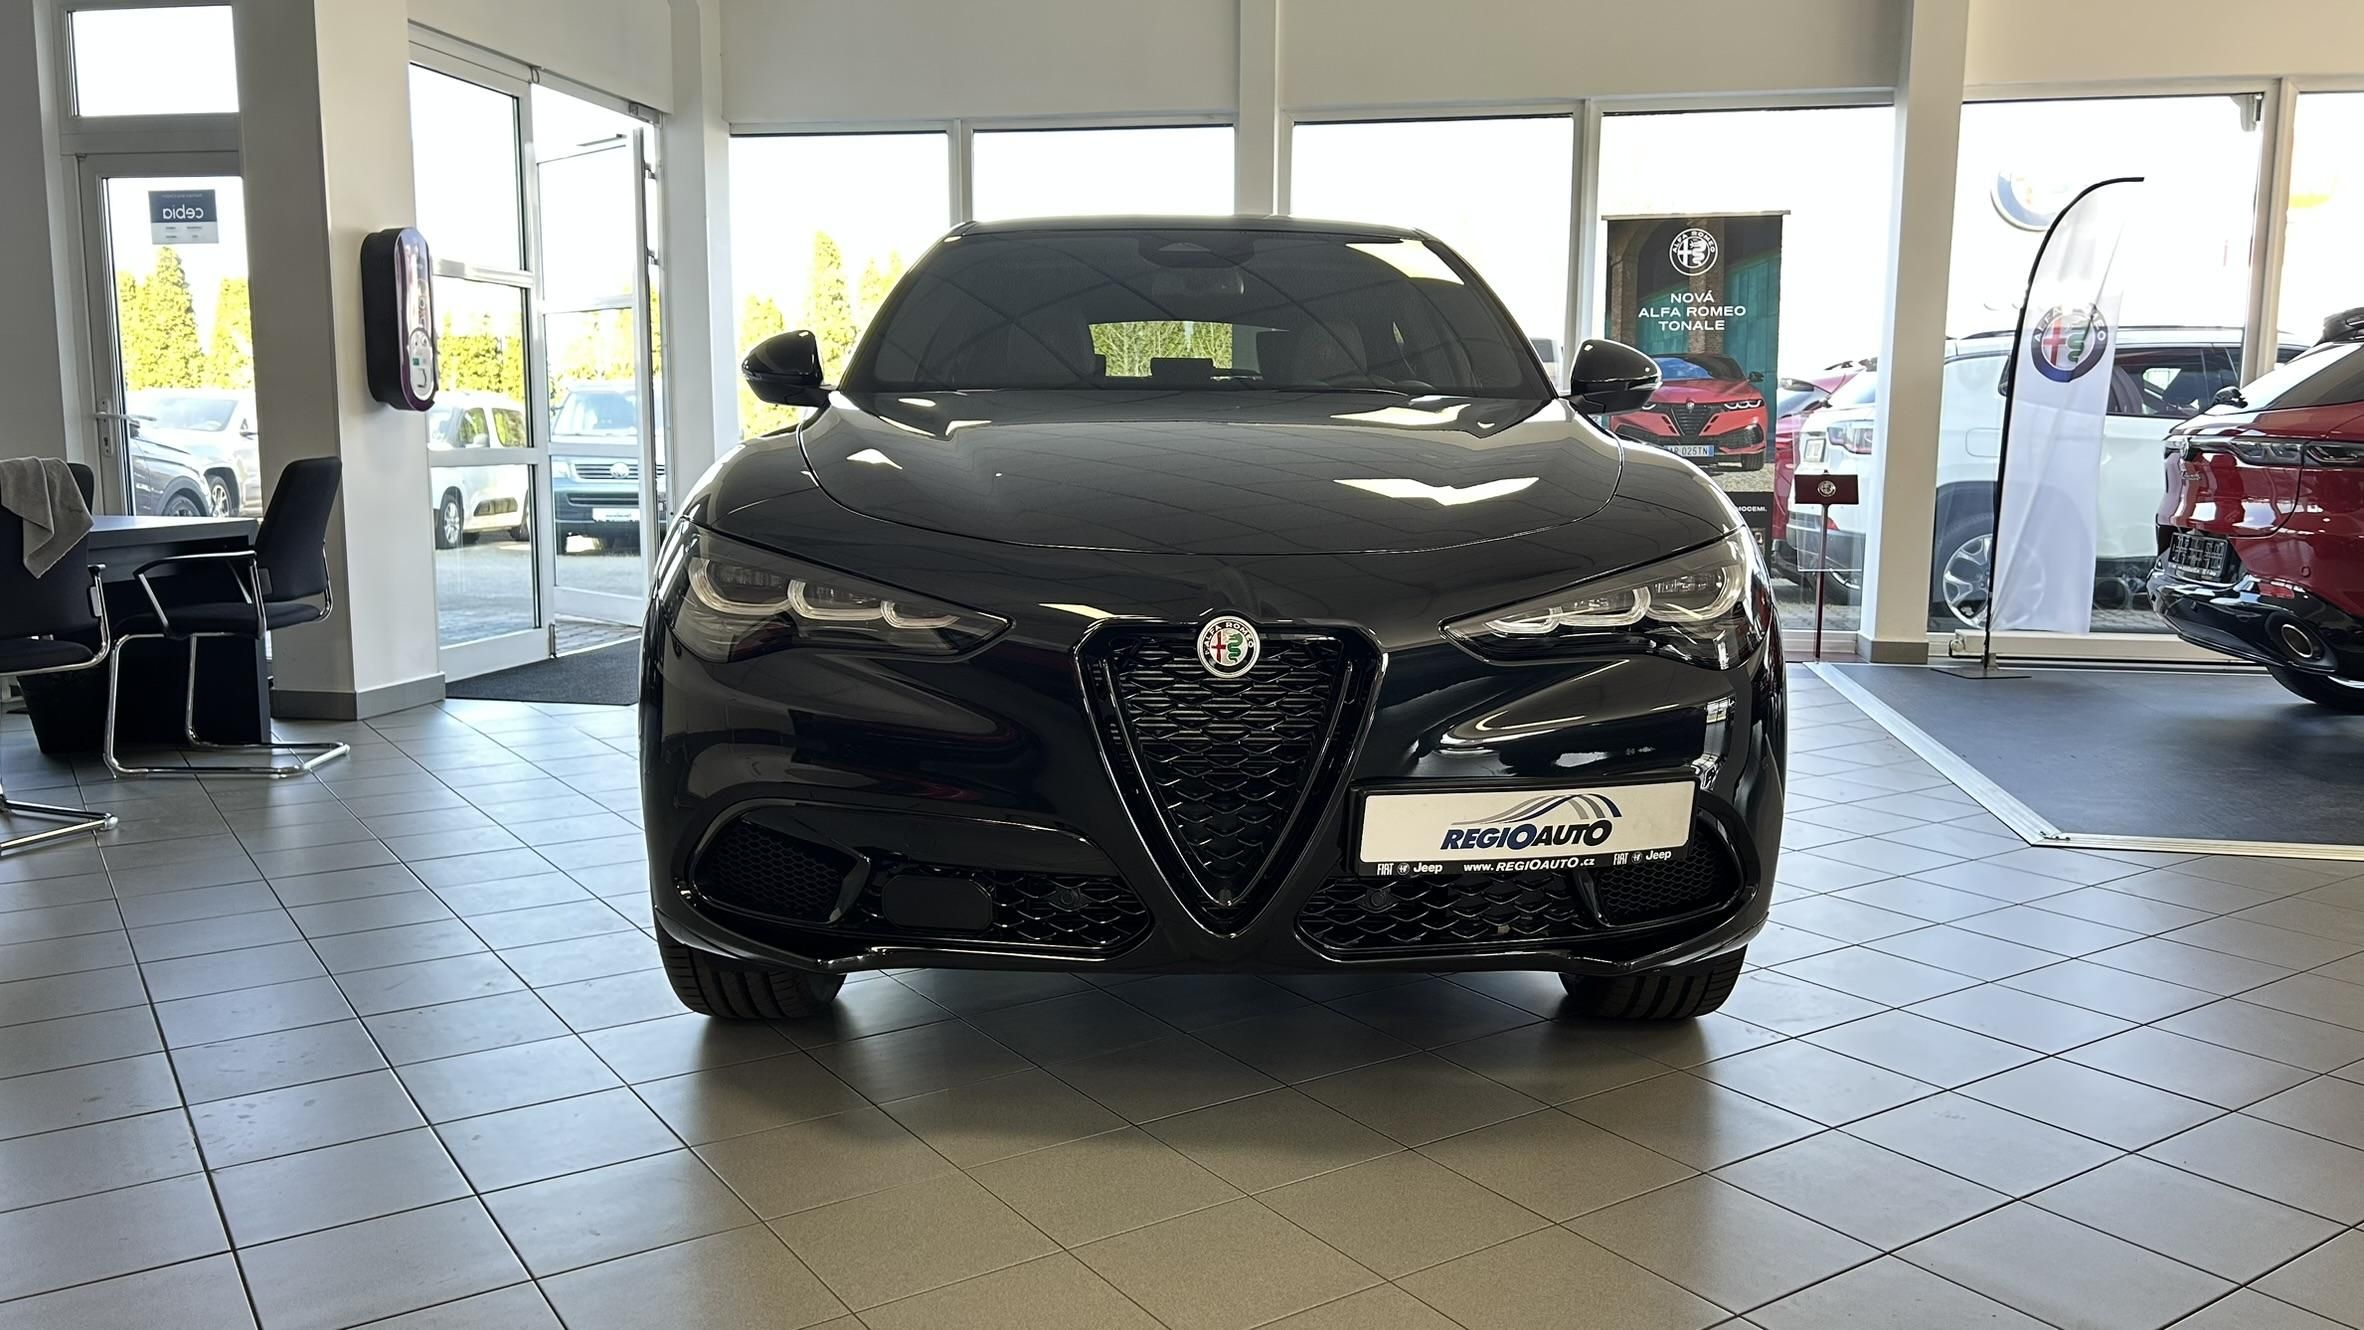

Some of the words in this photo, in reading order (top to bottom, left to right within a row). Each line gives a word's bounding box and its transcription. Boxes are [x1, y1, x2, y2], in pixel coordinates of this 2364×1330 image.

[1673, 234, 1688, 253] ALFA
[1691, 231, 1715, 253] ROMEO
[1670, 290, 1715, 303] NOVÁ
[1638, 307, 1681, 318] ALFA
[1686, 305, 1746, 317] ROMEO
[1658, 320, 1725, 331] TONALE
[1204, 625, 1222, 648] ALFA
[1225, 622, 1255, 648] ROMEO
[1440, 820, 1613, 850] REGIOAUTO
[1377, 863, 1394, 876] FIAT
[1413, 862, 1443, 875] Jeep
[1613, 852, 1629, 866] FIAT
[1645, 850, 1672, 861] Jeep
